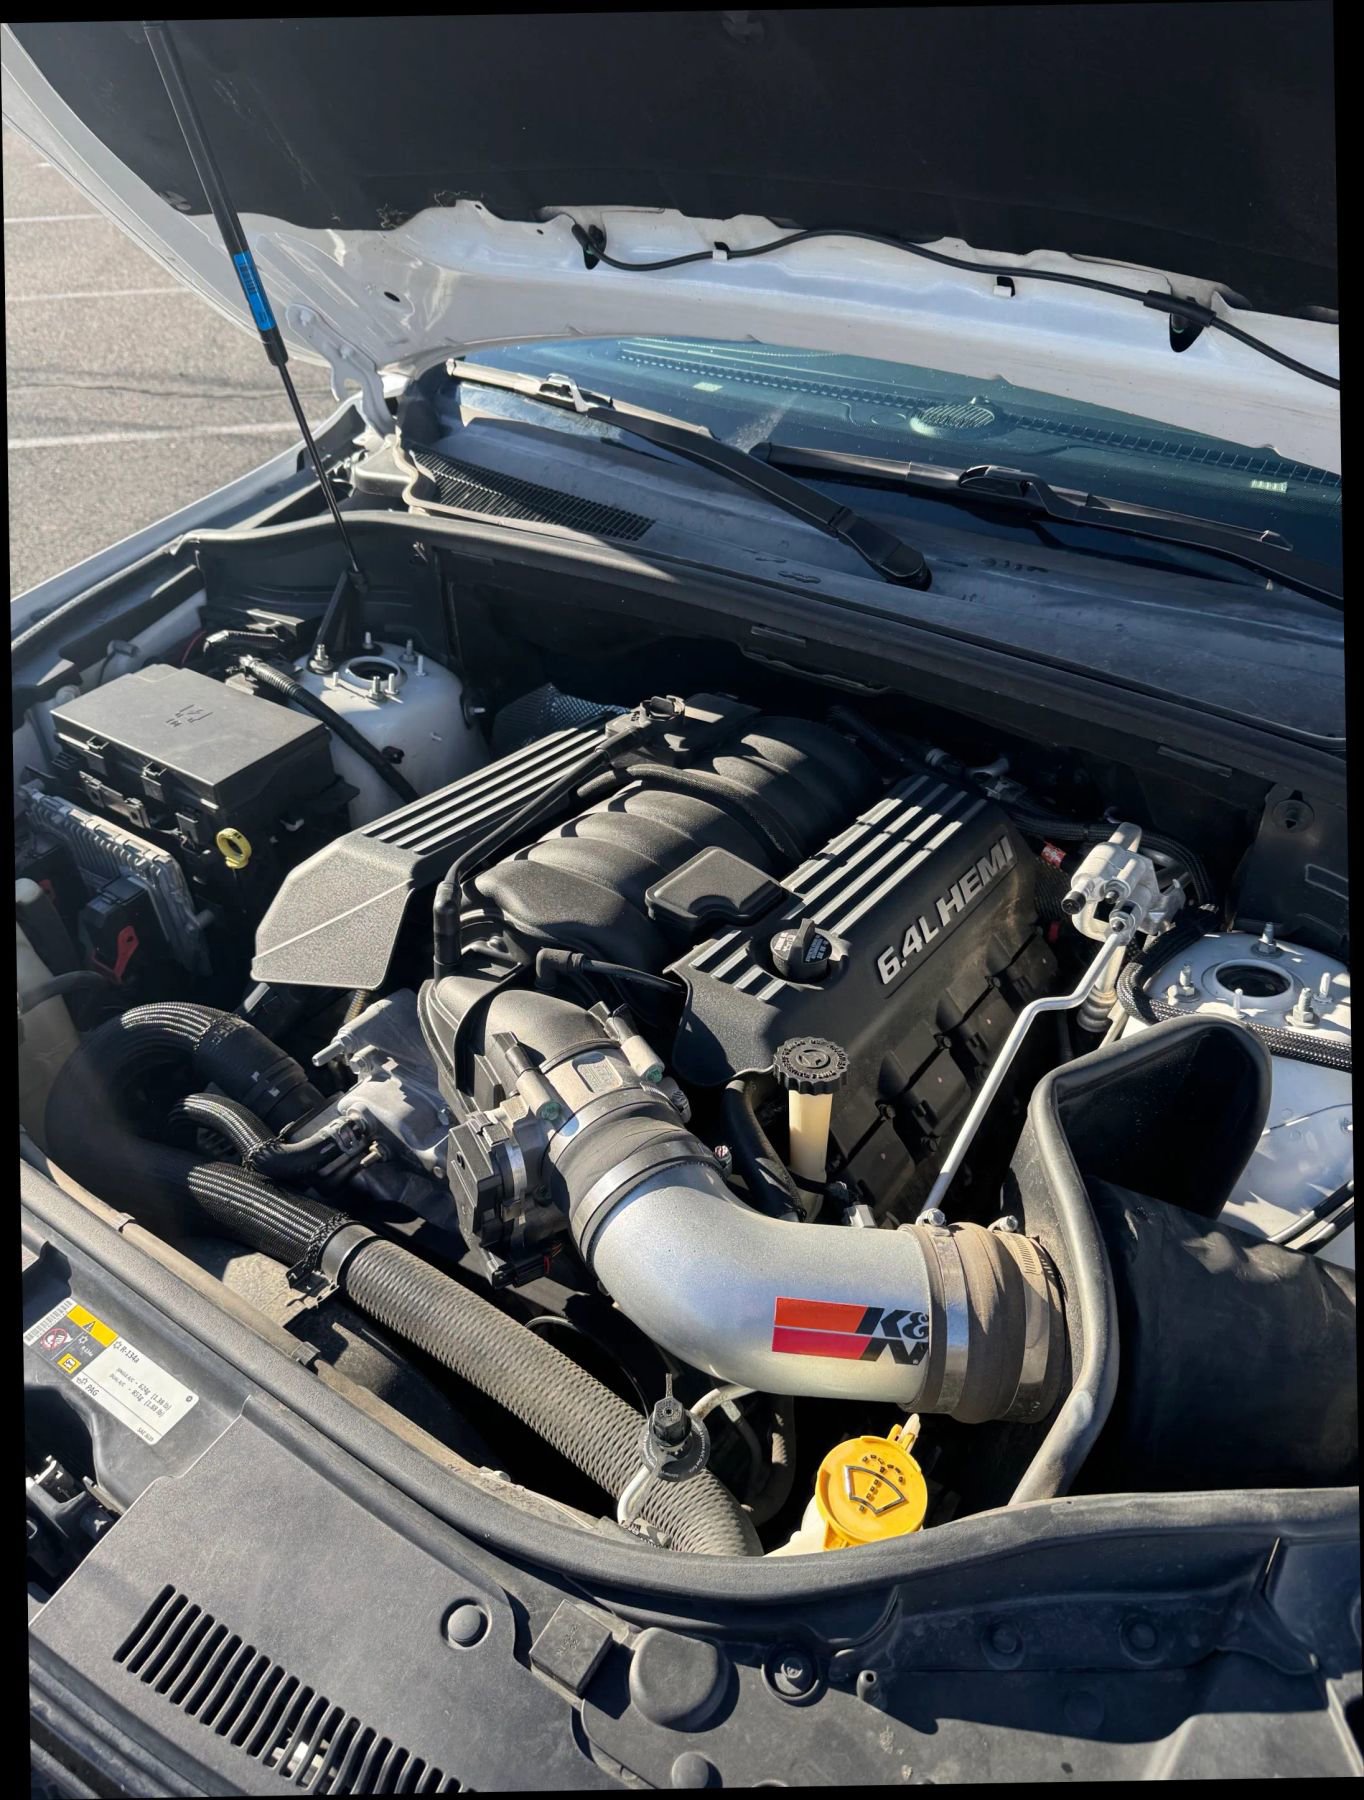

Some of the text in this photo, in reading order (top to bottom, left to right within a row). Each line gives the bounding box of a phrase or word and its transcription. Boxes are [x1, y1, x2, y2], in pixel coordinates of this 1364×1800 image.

[877, 836, 1015, 985] 6.4L HEMI
[855, 1306, 930, 1366] K&N
[120, 1345, 140, 1364] R-134a
[85, 1383, 100, 1397] PAG
[138, 1383, 152, 1398] 624g
